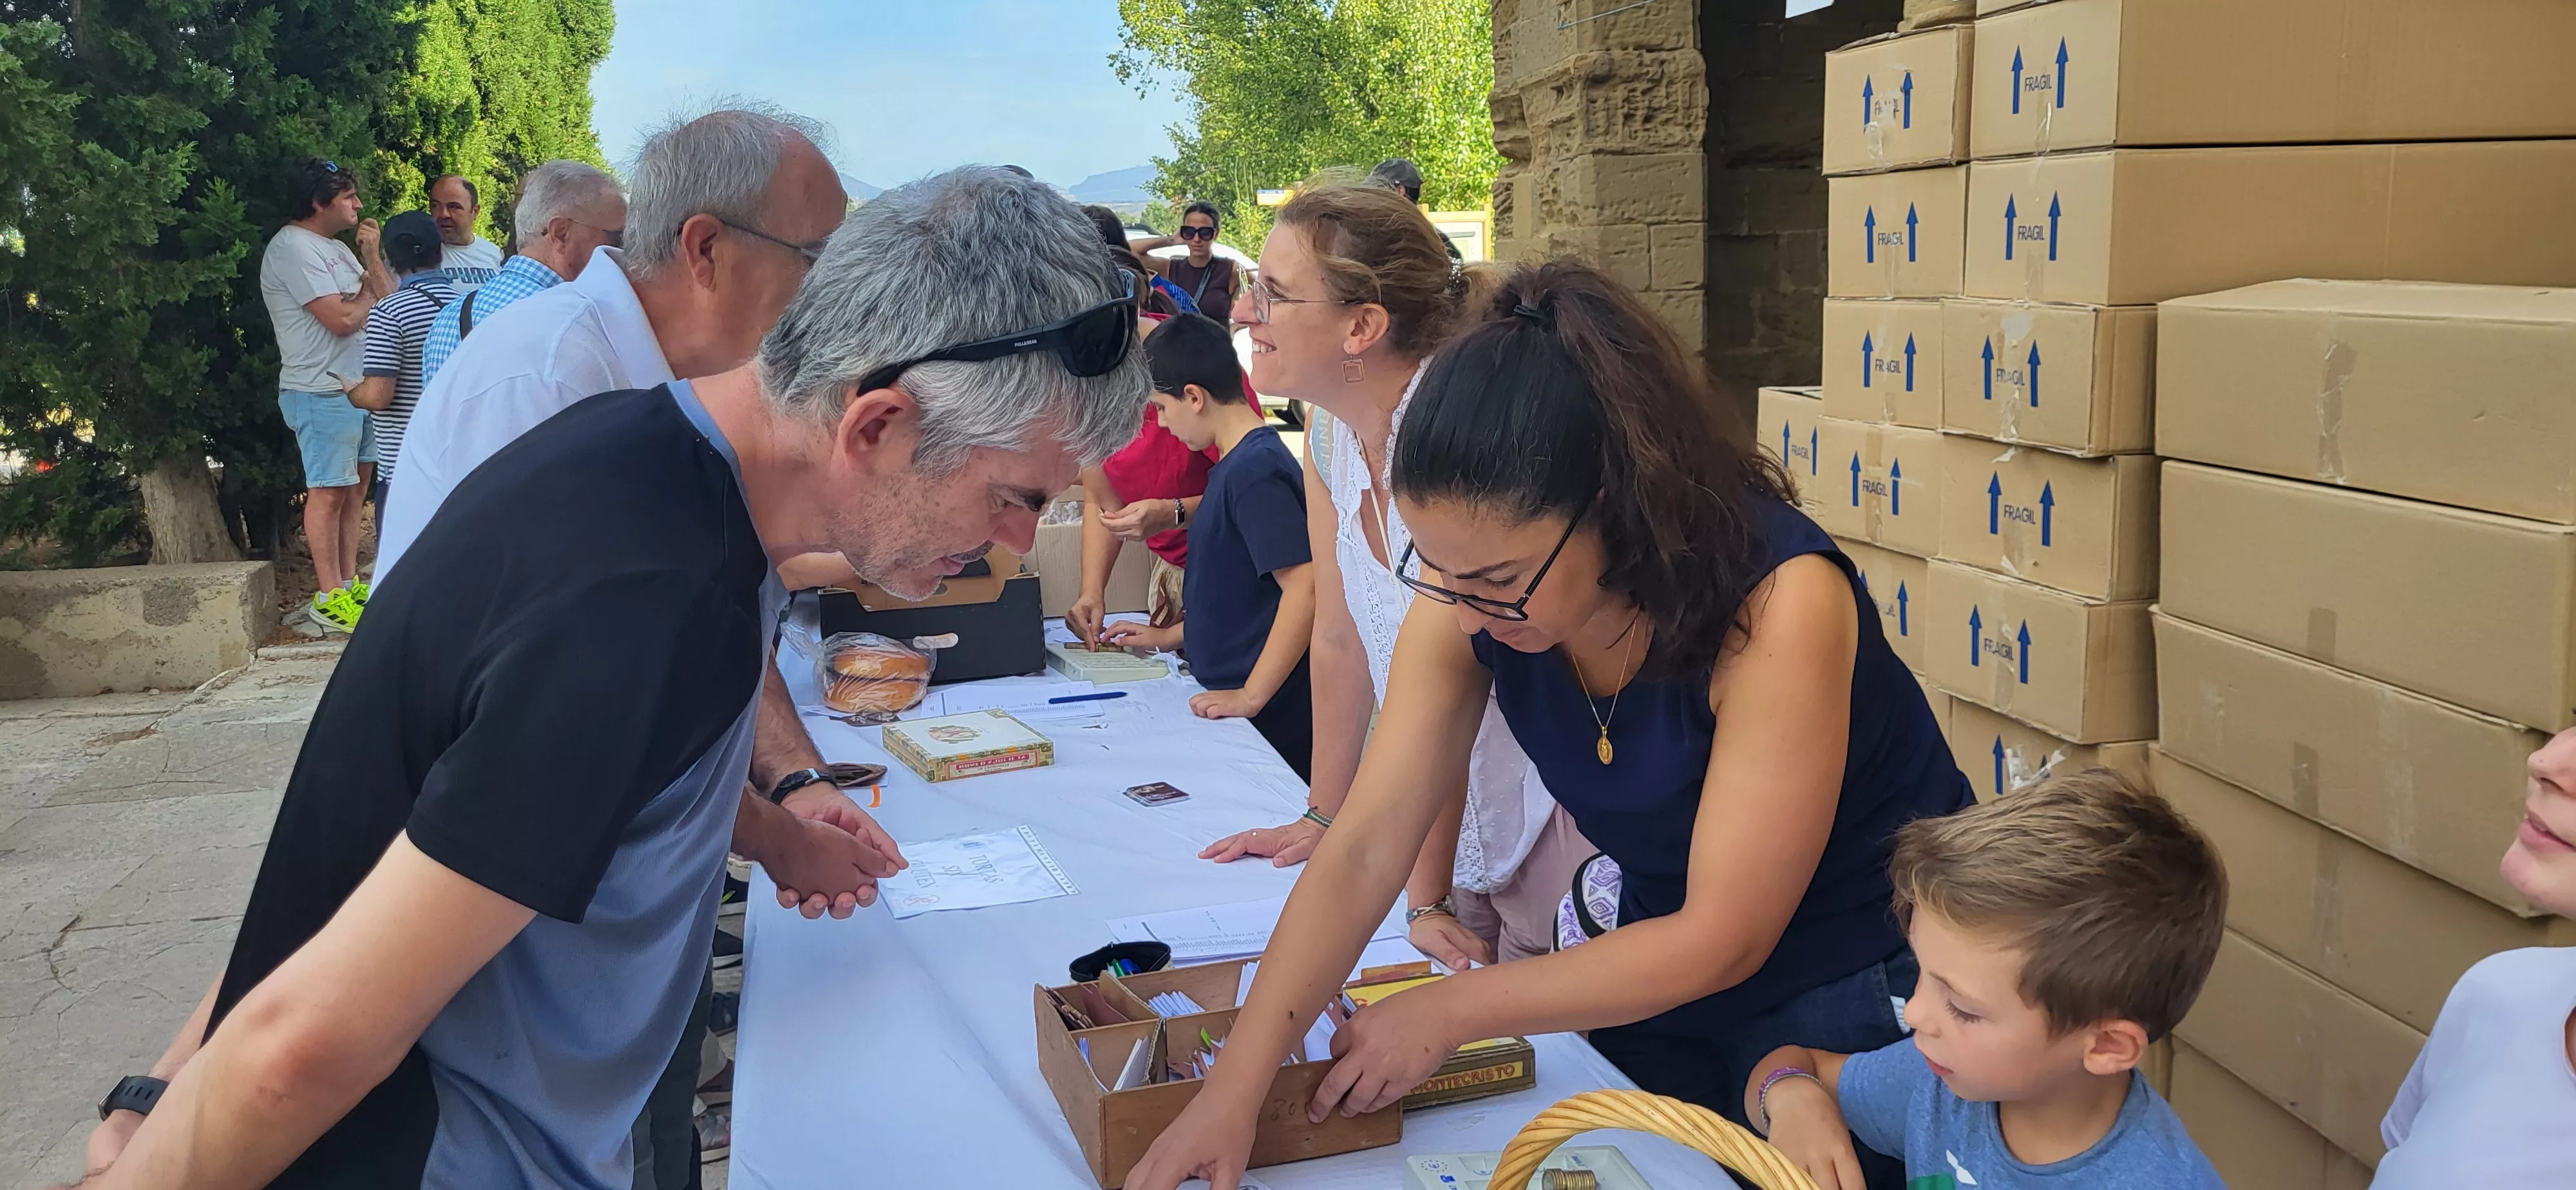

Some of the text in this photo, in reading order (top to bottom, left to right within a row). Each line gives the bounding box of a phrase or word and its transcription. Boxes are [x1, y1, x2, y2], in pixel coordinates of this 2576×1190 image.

[2025, 74, 2052, 91] FRAGIL
[1878, 232, 1904, 245] FRAGIL
[2018, 225, 2045, 240] FRAGIL
[1862, 480, 1888, 496] FRAGIL
[2003, 504, 2036, 524] FRAGIL
[969, 855, 1003, 883] TORTAS
[1410, 1064, 1515, 1093] MONTECRISTO
